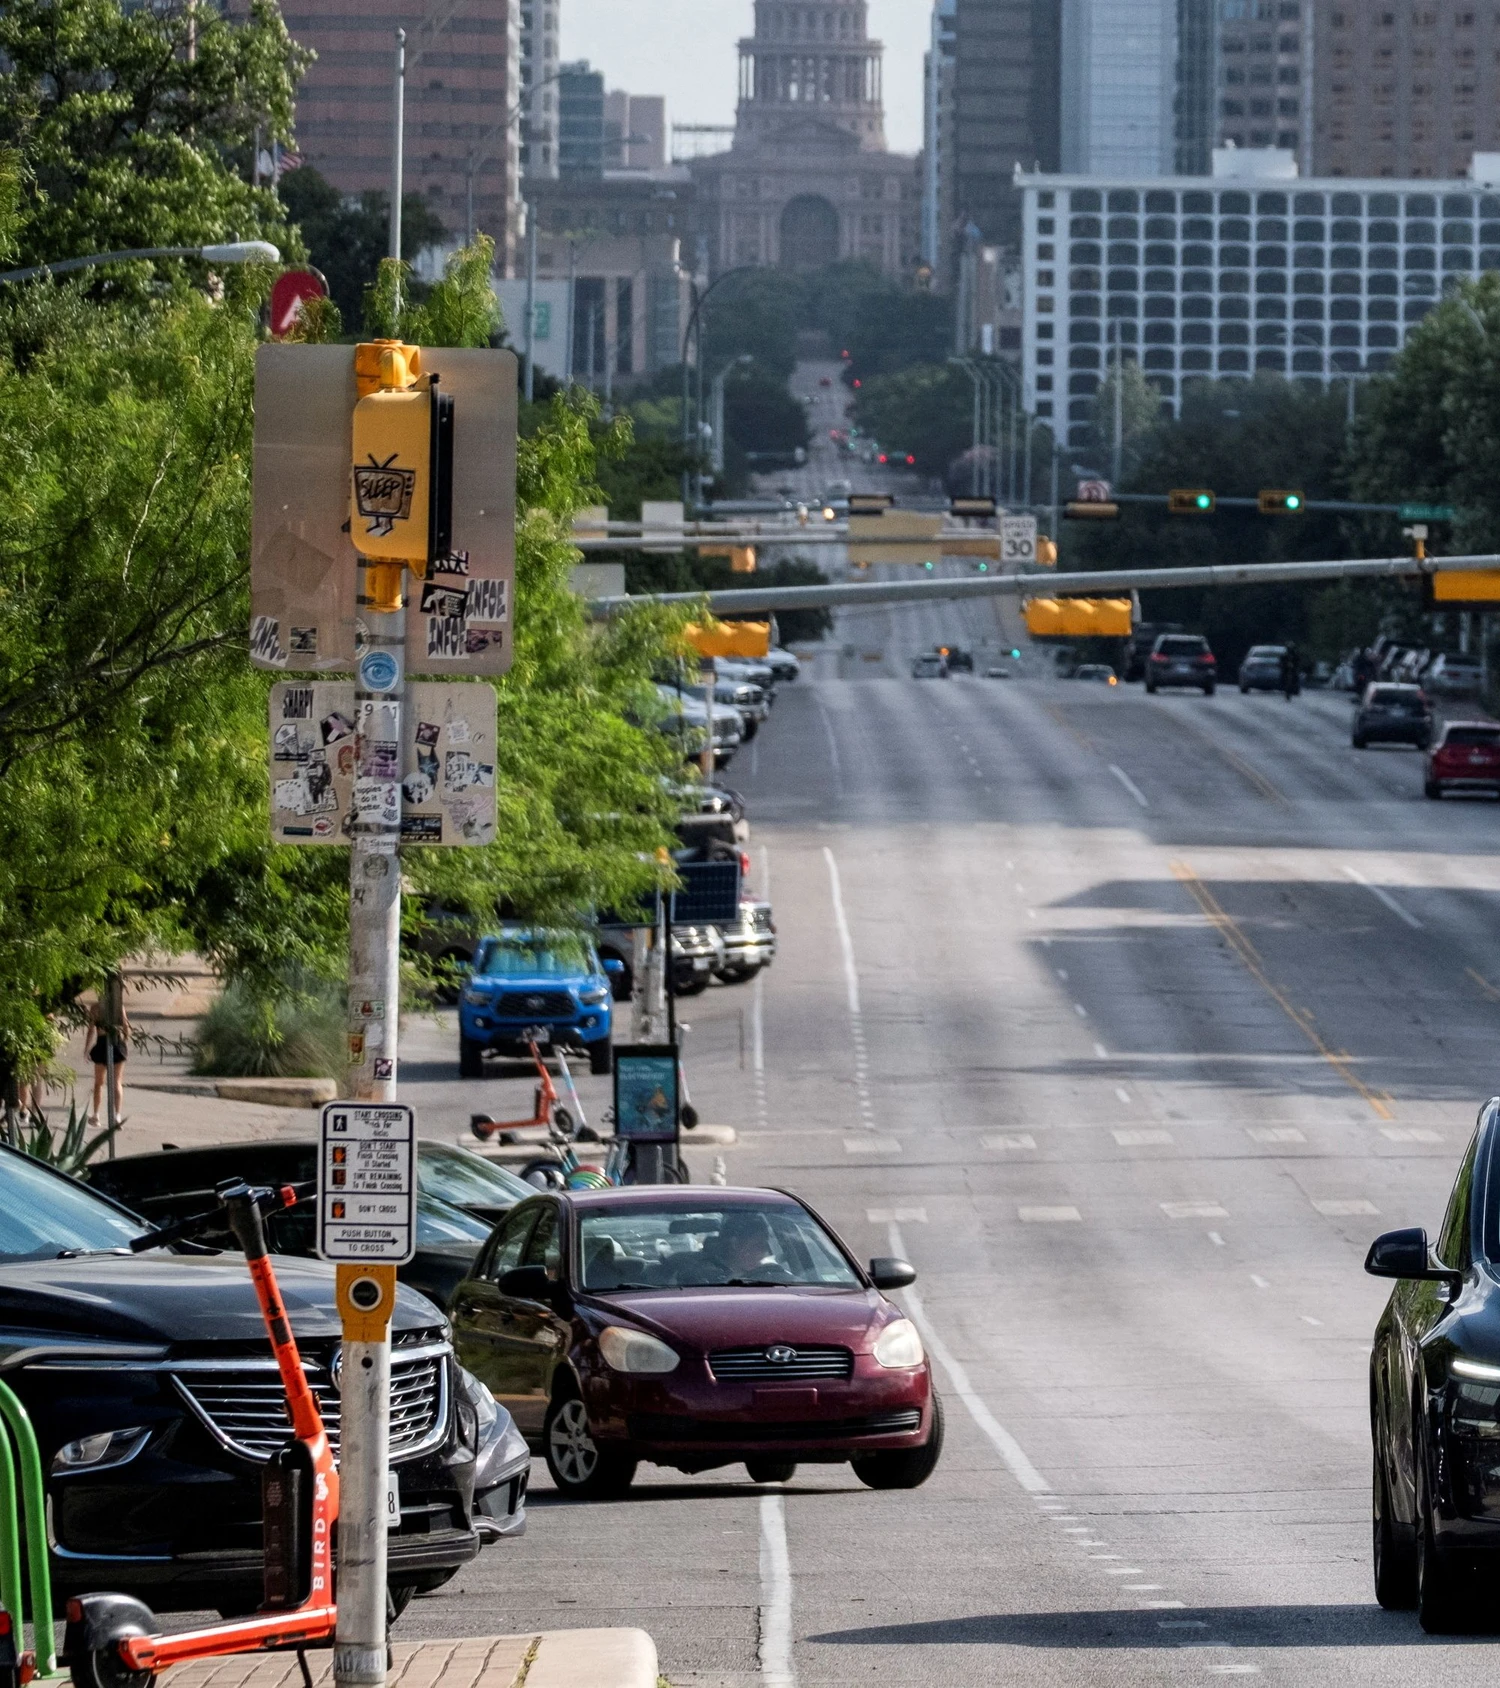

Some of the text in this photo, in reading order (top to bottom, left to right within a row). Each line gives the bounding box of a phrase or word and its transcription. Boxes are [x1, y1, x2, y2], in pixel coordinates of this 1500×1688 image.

[361, 477, 401, 500] SLEEP
[1006, 539, 1033, 557] 30
[354, 1110, 403, 1120] START CROSSING
[359, 1142, 396, 1150] DON'T START
[357, 1151, 398, 1161] Finish Crossing
[371, 1160, 391, 1168] Started
[353, 1172, 402, 1181] TIME REMAINING
[361, 1181, 377, 1189] Finish
[380, 1182, 403, 1191] Crossing
[358, 1205, 397, 1213] DON'T CROSS
[341, 1229, 391, 1238] PUSH BUTTON
[348, 1244, 385, 1252] TO CROSS
[312, 1518, 327, 1590] BIRD
